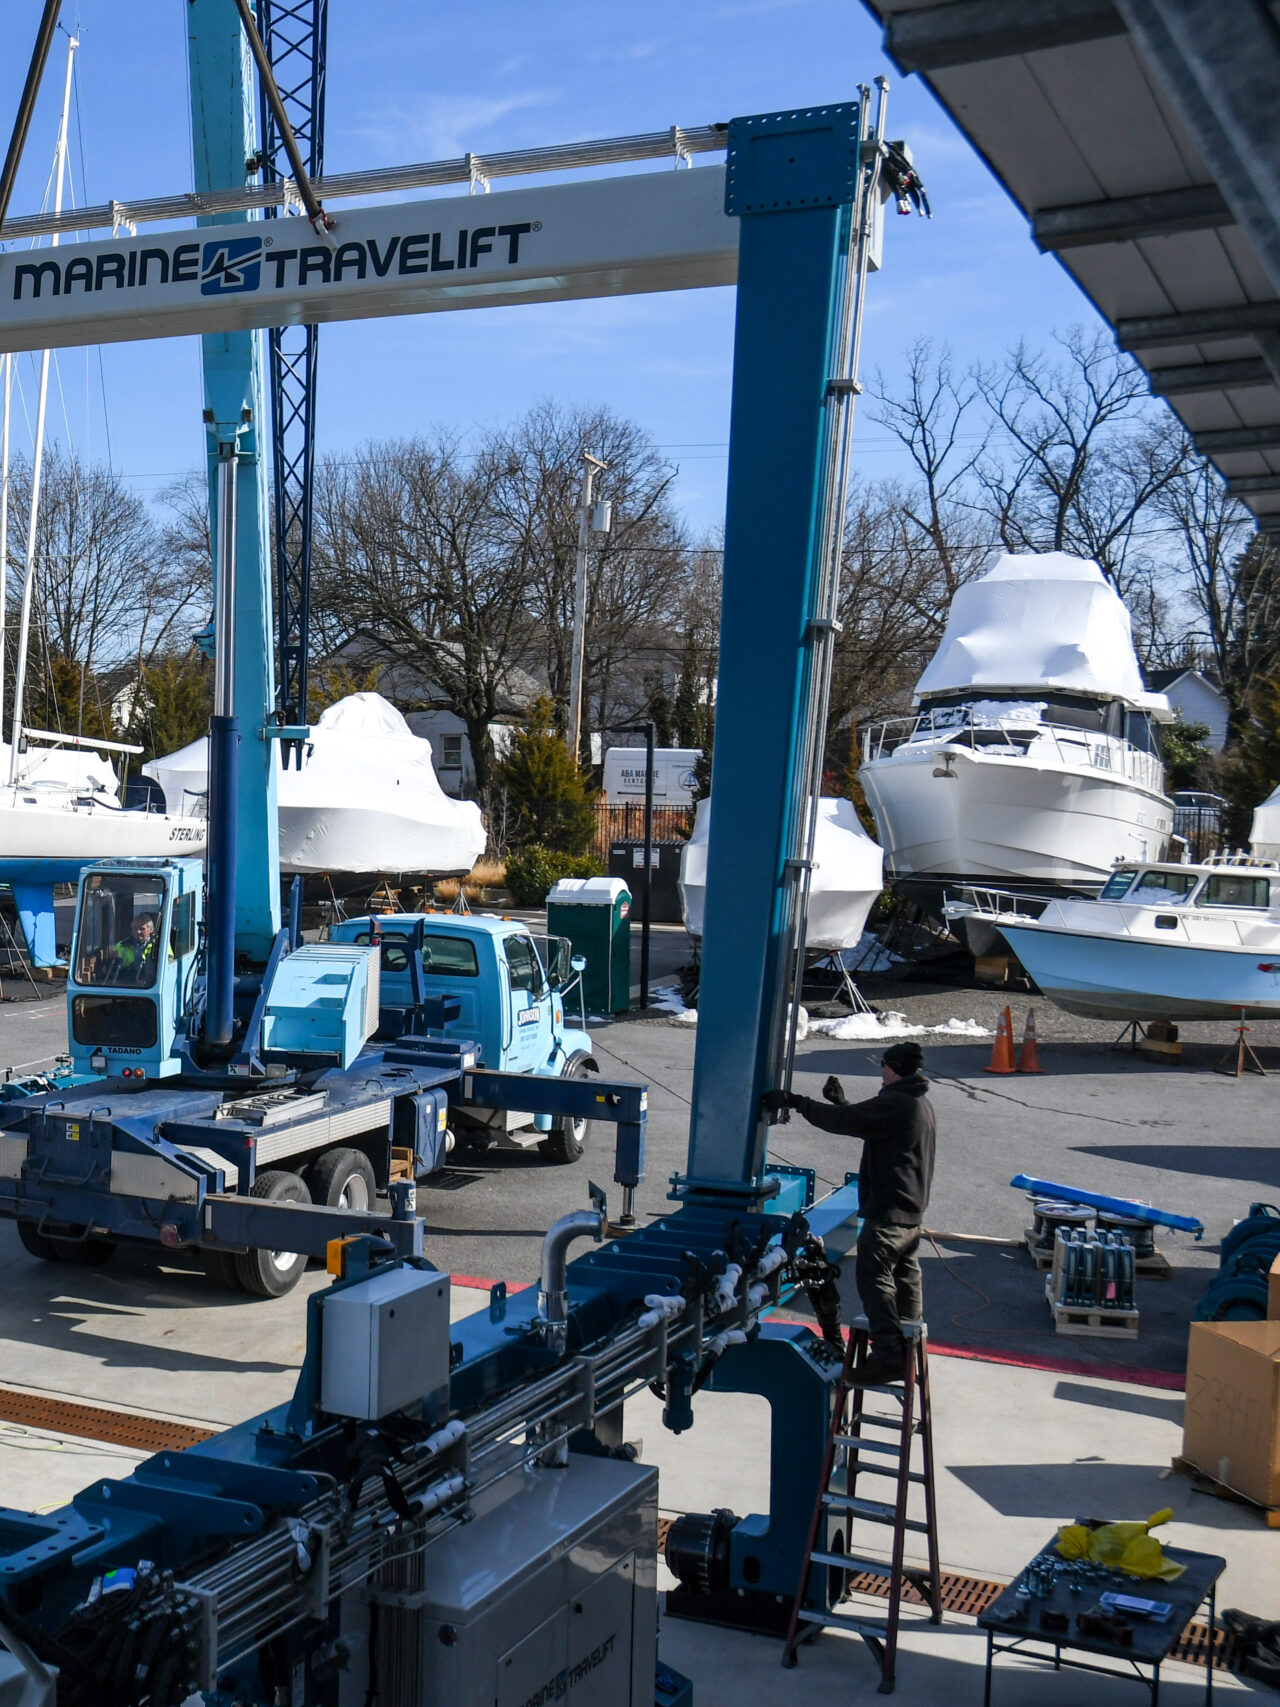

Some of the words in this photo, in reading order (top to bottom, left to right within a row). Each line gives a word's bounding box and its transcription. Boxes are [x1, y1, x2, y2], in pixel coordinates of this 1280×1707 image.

[13, 243, 201, 301] MARINE
[169, 827, 206, 841] STERLING
[108, 1047, 142, 1055] TADANO
[520, 1678, 555, 1707] ARINE
[568, 1633, 616, 1688] TRAVELIFT
